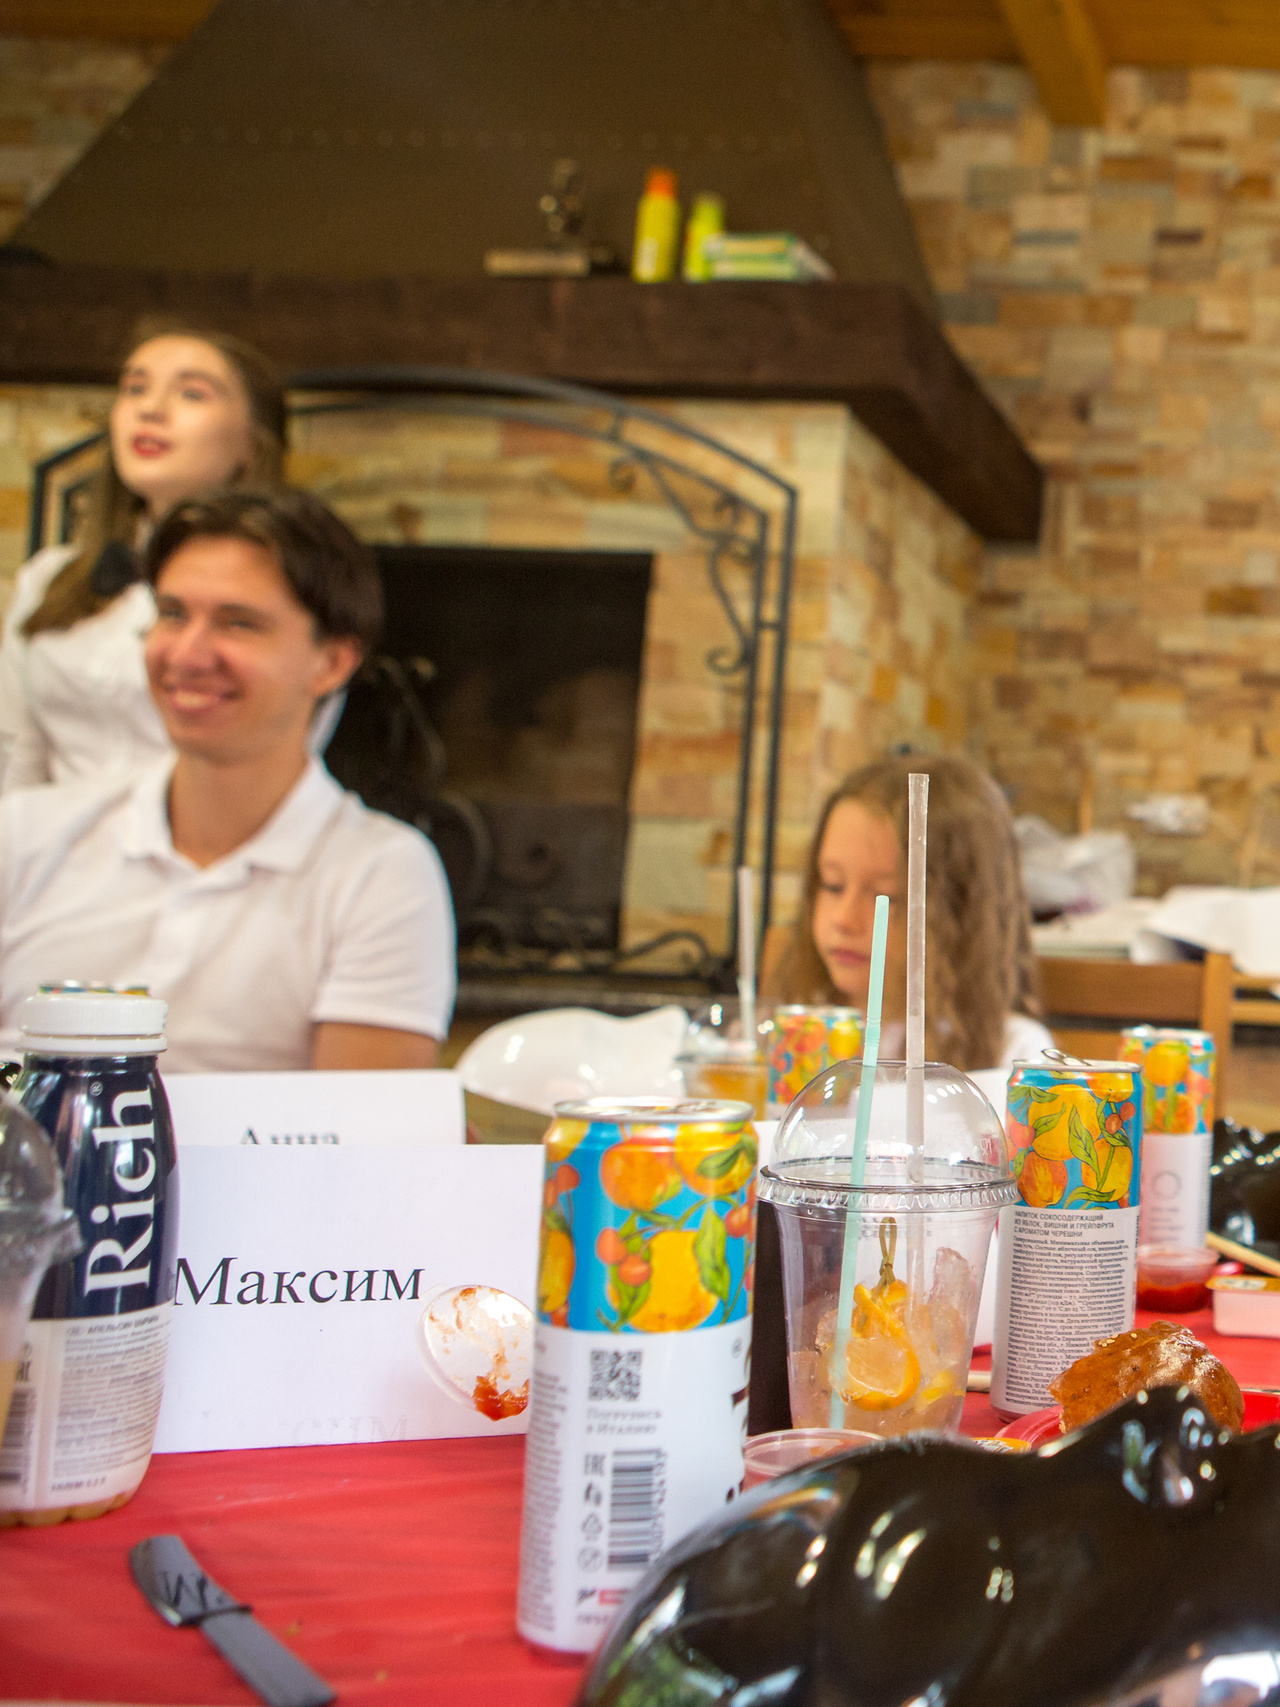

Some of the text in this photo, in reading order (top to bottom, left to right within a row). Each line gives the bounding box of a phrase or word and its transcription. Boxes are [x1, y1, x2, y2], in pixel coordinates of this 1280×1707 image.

[84, 1085, 155, 1297] Rich
[1015, 1210, 1104, 1222] НАПИТОК СОКОСОДЕРЖАЩИЙ
[1014, 1218, 1021, 1226] ИЗ
[1021, 1219, 1043, 1228] ЯБЛОК,
[1044, 1221, 1068, 1229] ВИШНИ
[1018, 1227, 1049, 1236] АРОМАТОМ
[174, 1256, 426, 1306] Максим
